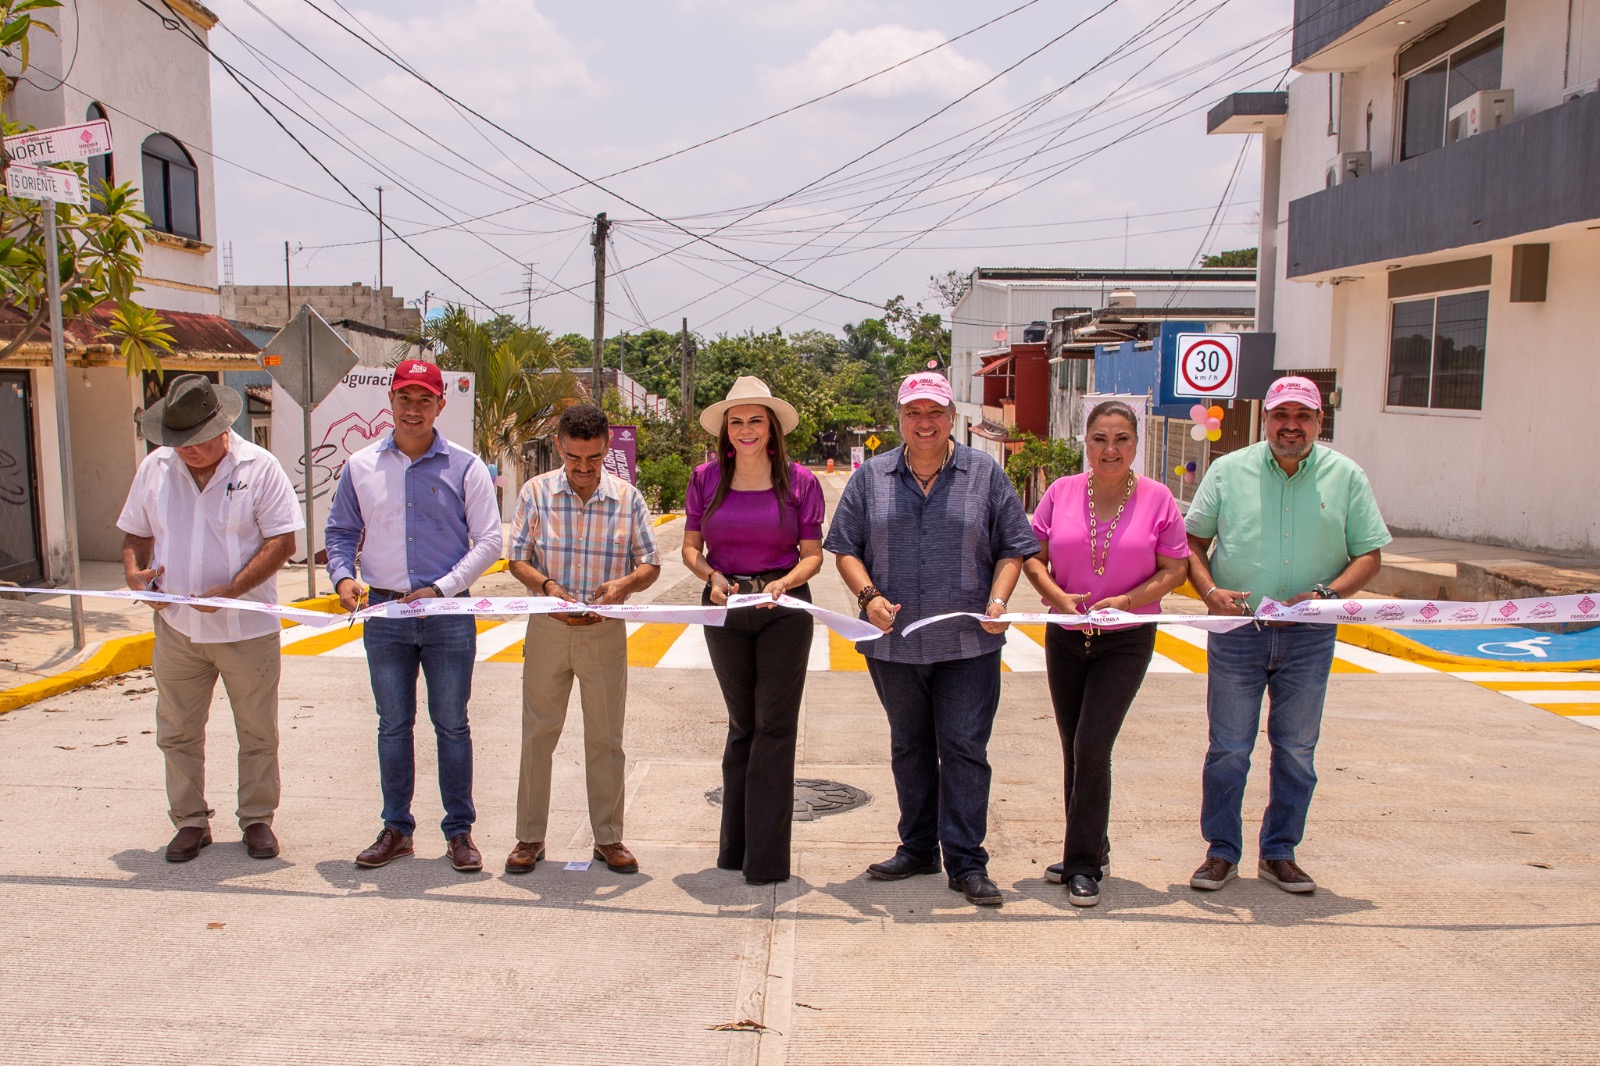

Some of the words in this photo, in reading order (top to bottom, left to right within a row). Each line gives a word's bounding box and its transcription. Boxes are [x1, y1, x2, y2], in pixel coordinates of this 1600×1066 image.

[9, 174, 20, 189] 15
[22, 175, 58, 193] ORIENTE
[1195, 350, 1220, 373] 30
[1336, 614, 1367, 622] TAPACHULA
